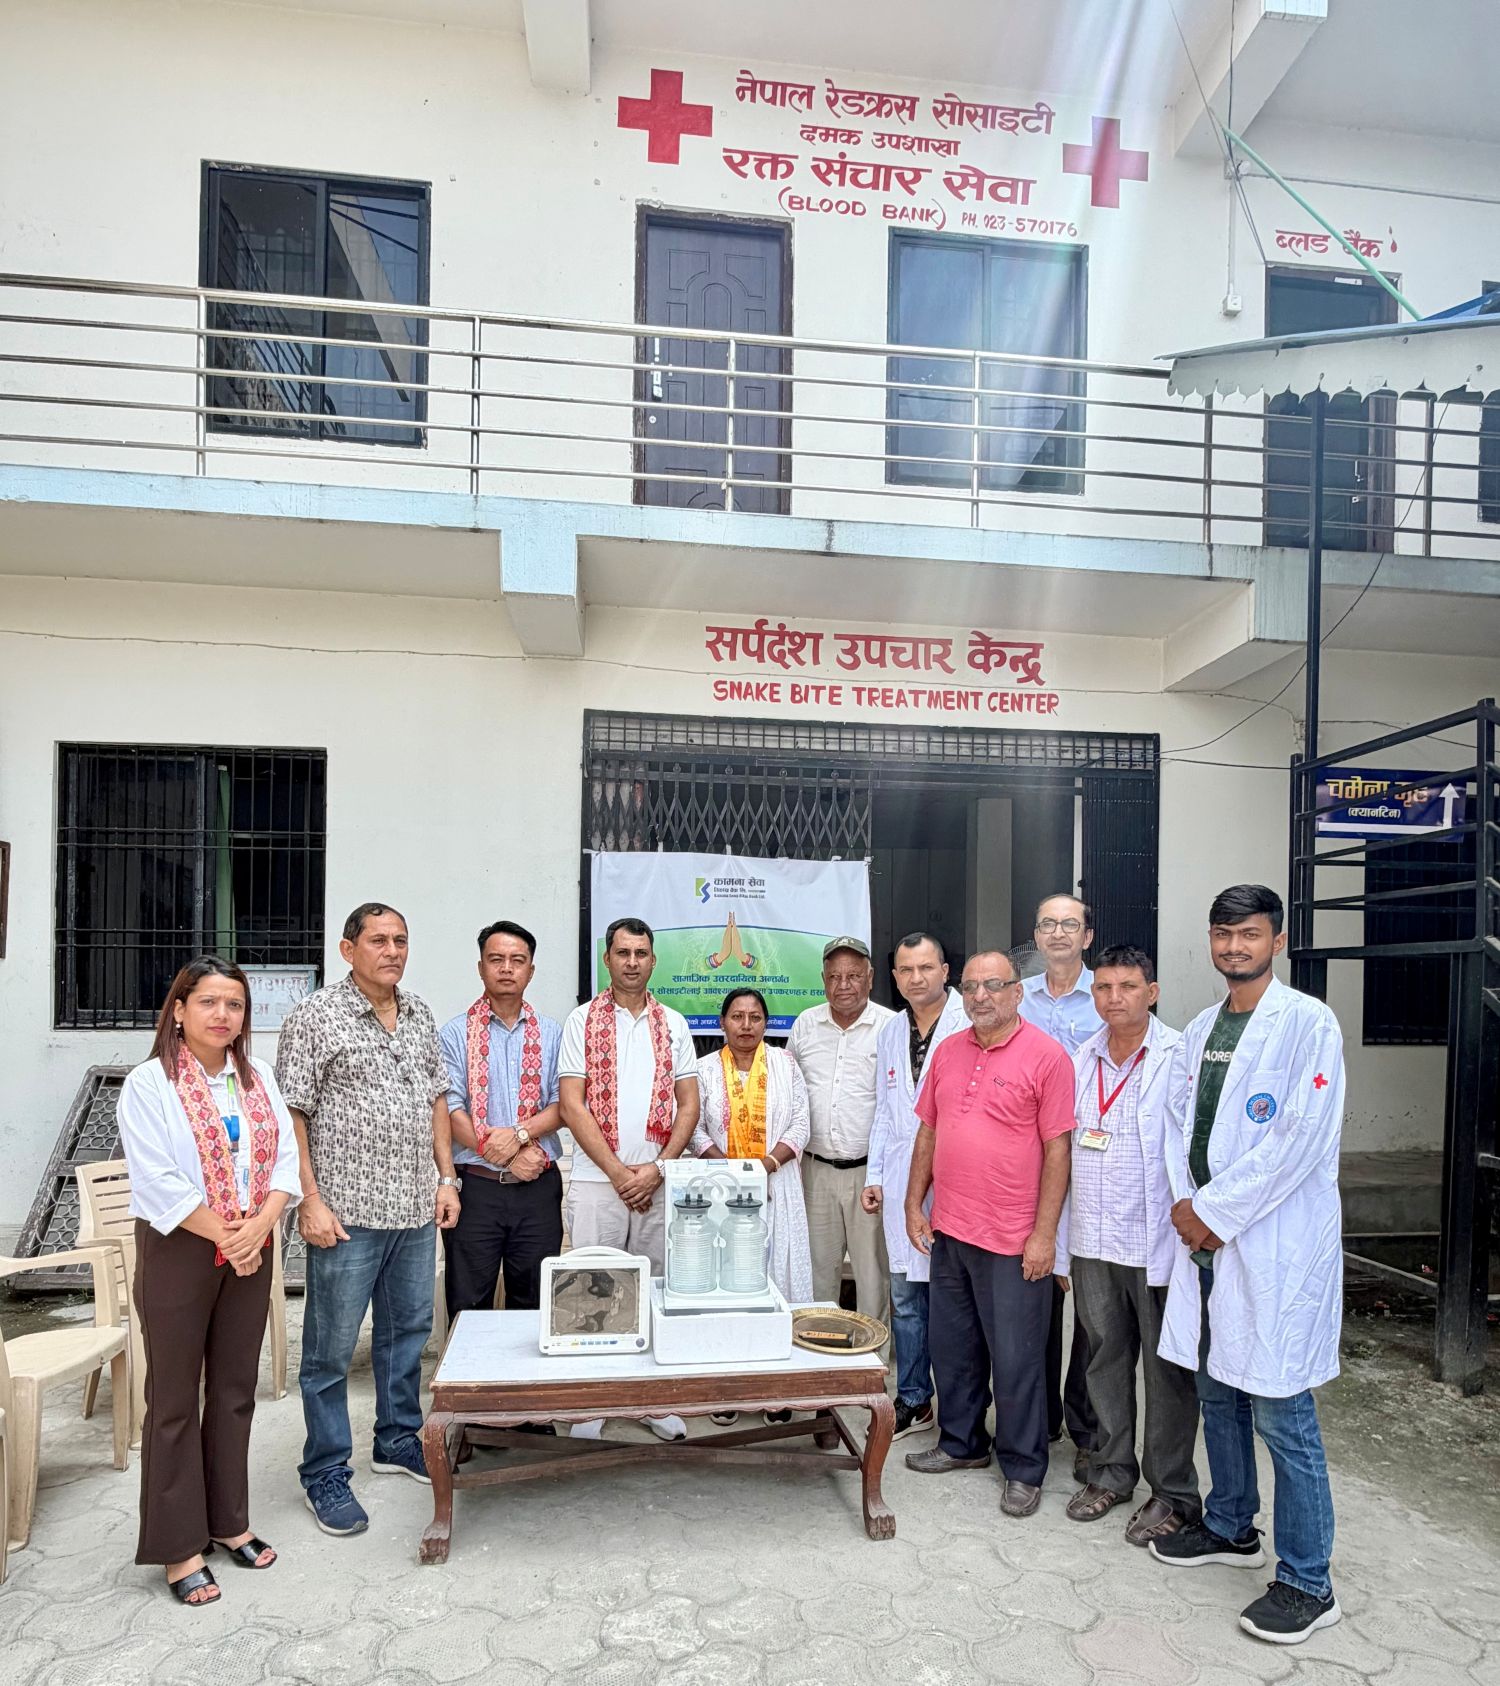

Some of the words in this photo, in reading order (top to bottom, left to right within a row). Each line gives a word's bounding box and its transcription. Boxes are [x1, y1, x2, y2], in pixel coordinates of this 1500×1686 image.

[736, 69, 816, 112] नेपाल
[825, 79, 919, 124] रेडक्रस
[932, 92, 1056, 136] सोसाइटी
[800, 123, 862, 146] दमक
[871, 131, 961, 157] उपशाखा
[722, 148, 798, 181] रक्त
[811, 152, 932, 197] संचार
[943, 164, 1037, 206] सेवा
[777, 186, 867, 218] (BLOOD
[882, 203, 948, 232] BANK)
[960, 212, 979, 229] PH.
[983, 214, 1078, 238] 023-570176
[1275, 229, 1331, 257] ब्लड
[705, 618, 824, 670] सर्पदंश
[832, 633, 956, 675] उपचार
[966, 630, 1046, 687] केन्द्र
[712, 679, 782, 704] SNAKE
[789, 683, 843, 706] BITE
[851, 686, 984, 712] TREATMENT
[986, 691, 1060, 717] CENTER
[713, 877, 745, 887] कामना
[748, 876, 765, 887] सेवा
[672, 973, 710, 983] सामाजिक
